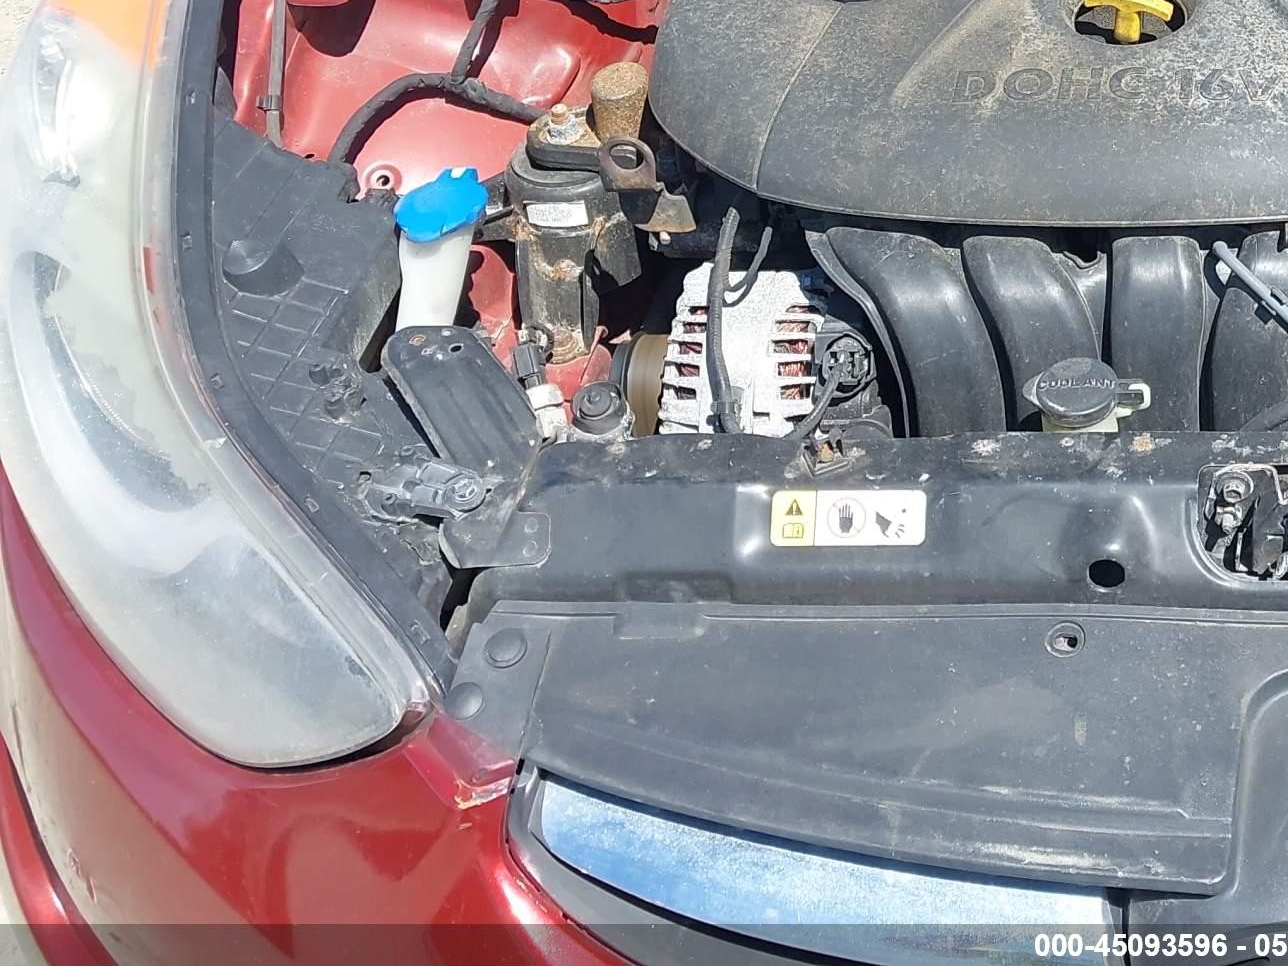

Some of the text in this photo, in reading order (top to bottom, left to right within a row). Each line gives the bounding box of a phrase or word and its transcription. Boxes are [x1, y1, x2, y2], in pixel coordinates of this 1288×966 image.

[951, 66, 1281, 103] DOHC 16V
[1039, 377, 1116, 392] COOLANT
